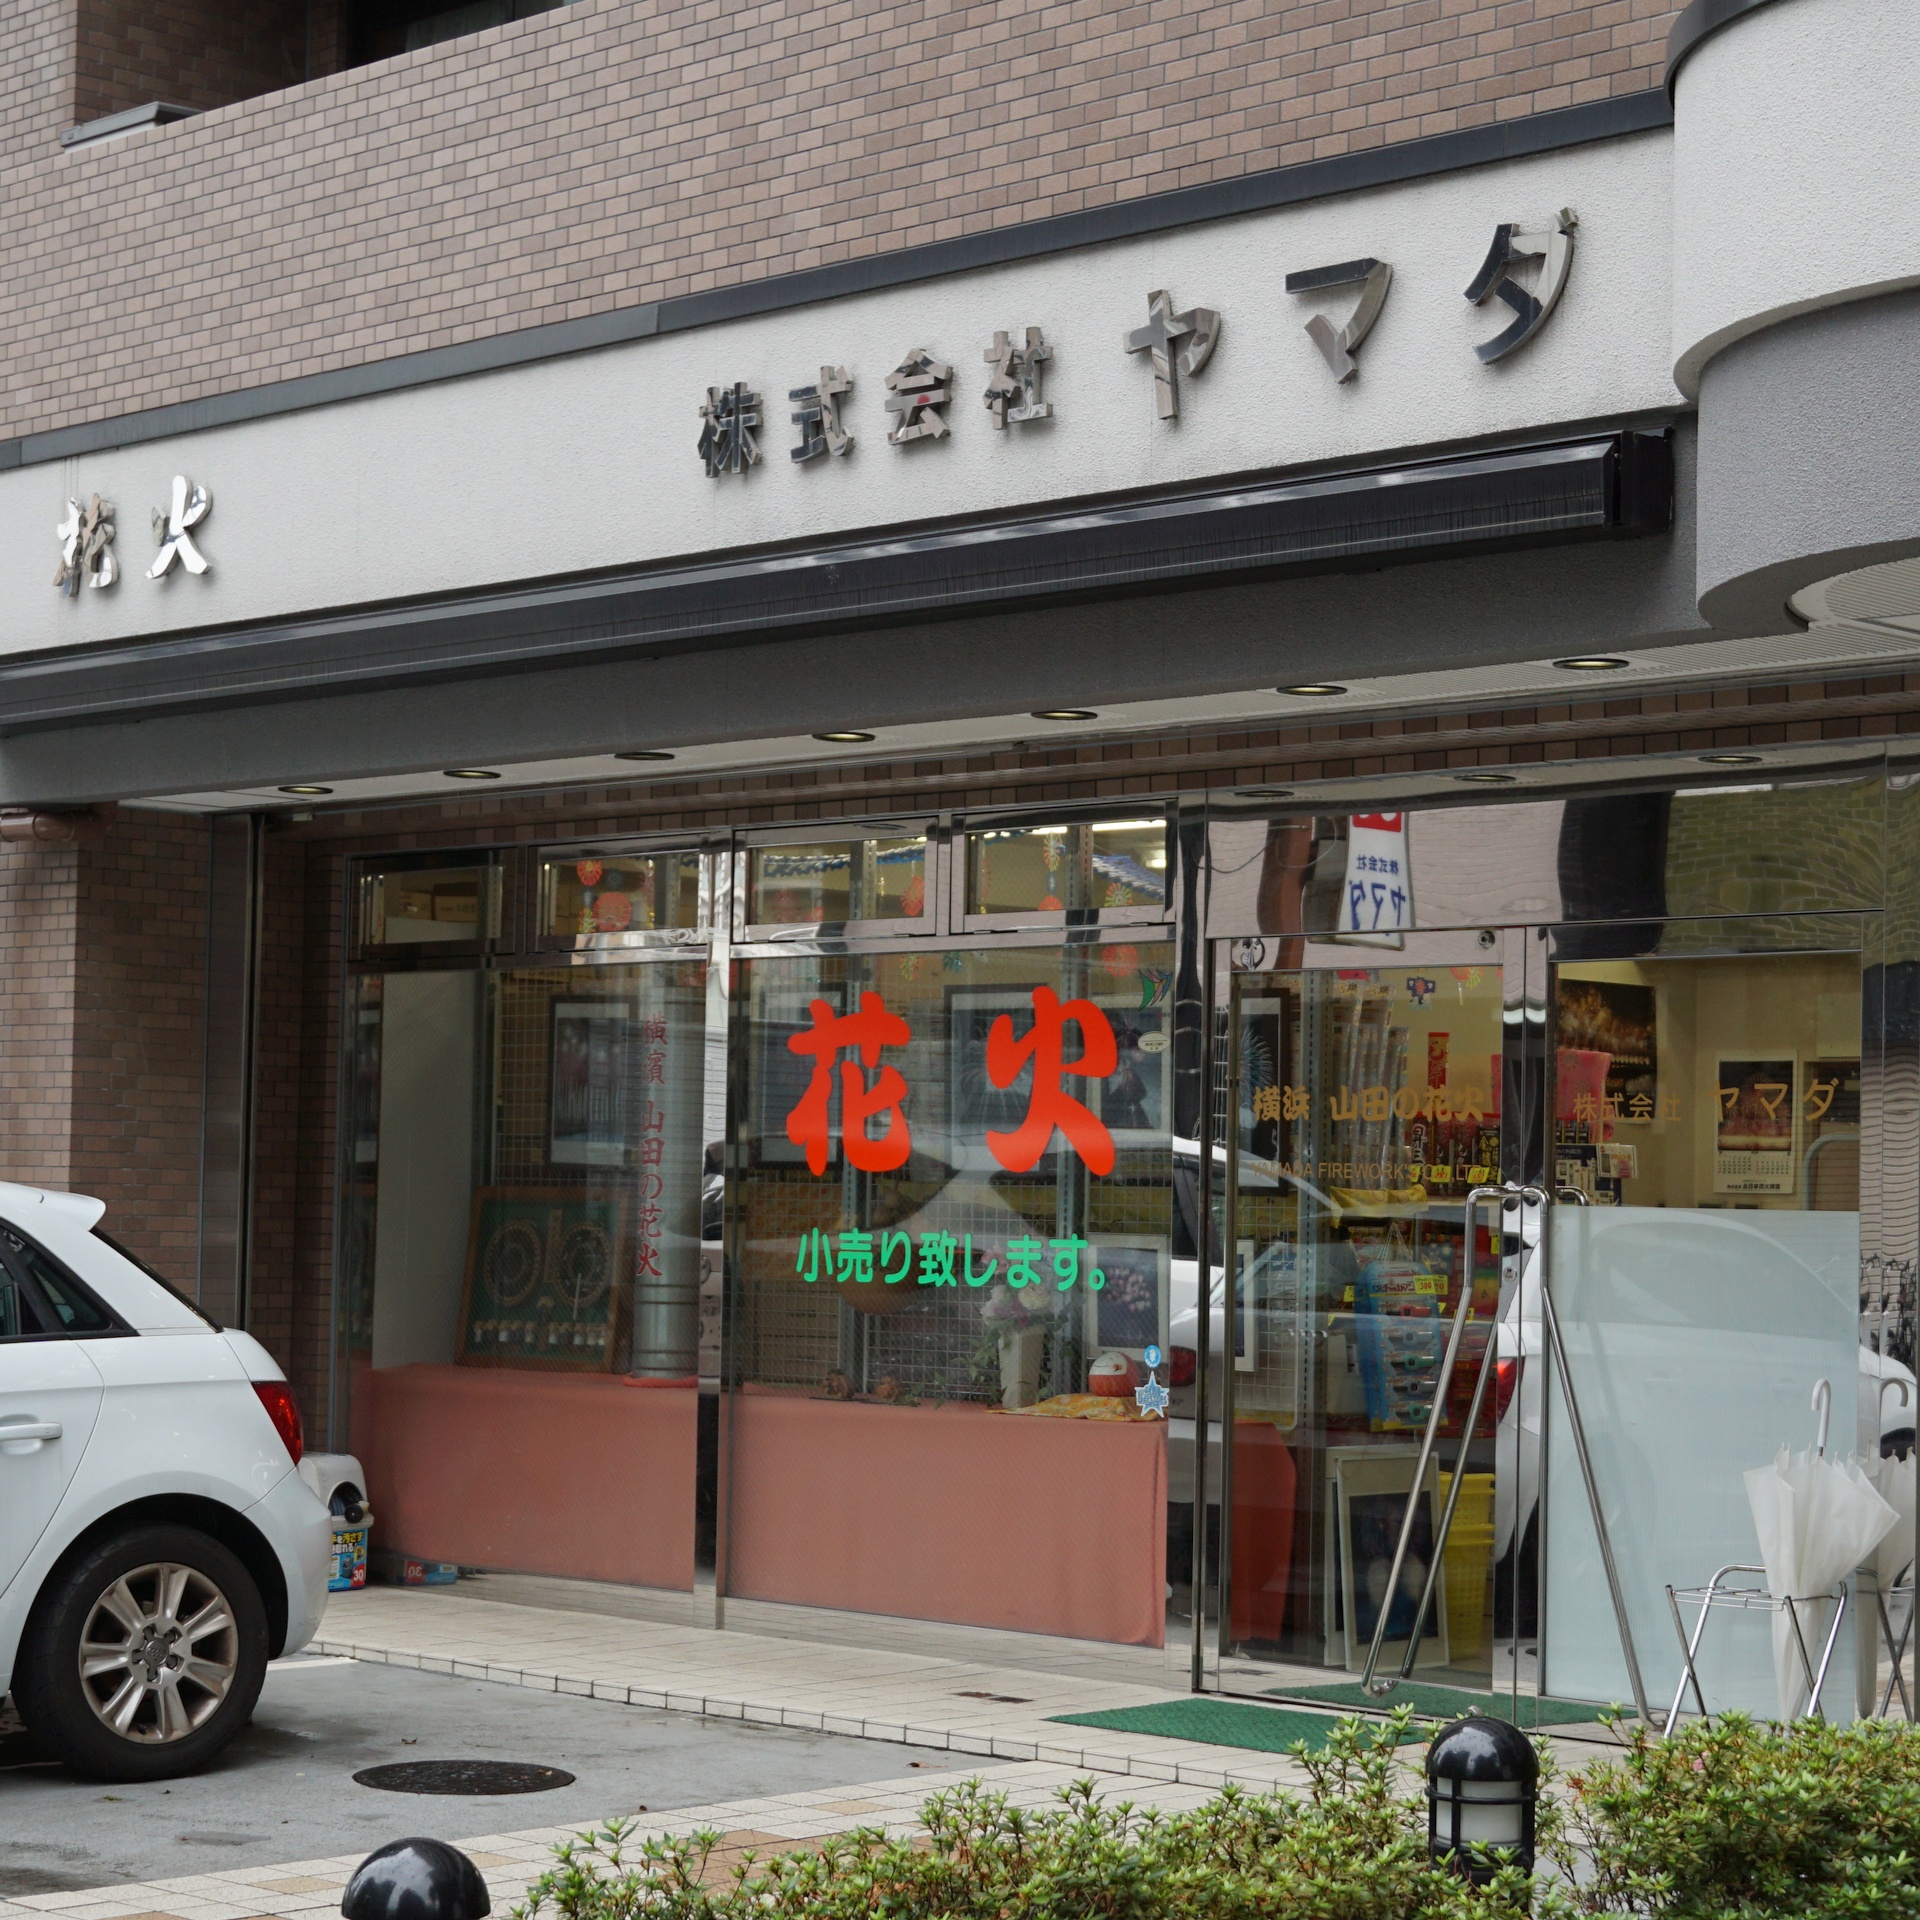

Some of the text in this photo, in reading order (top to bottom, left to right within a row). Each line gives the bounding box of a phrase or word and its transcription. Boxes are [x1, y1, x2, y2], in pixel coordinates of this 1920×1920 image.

[787, 986, 1117, 1176] 花火
[1253, 1084, 1484, 1122] 横浜 山田の花火
[1574, 1077, 1839, 1122] 株式会社 ヤマダ
[637, 1100, 667, 1277] 山田の花火
[796, 1227, 1105, 1291] 小売り致します。
